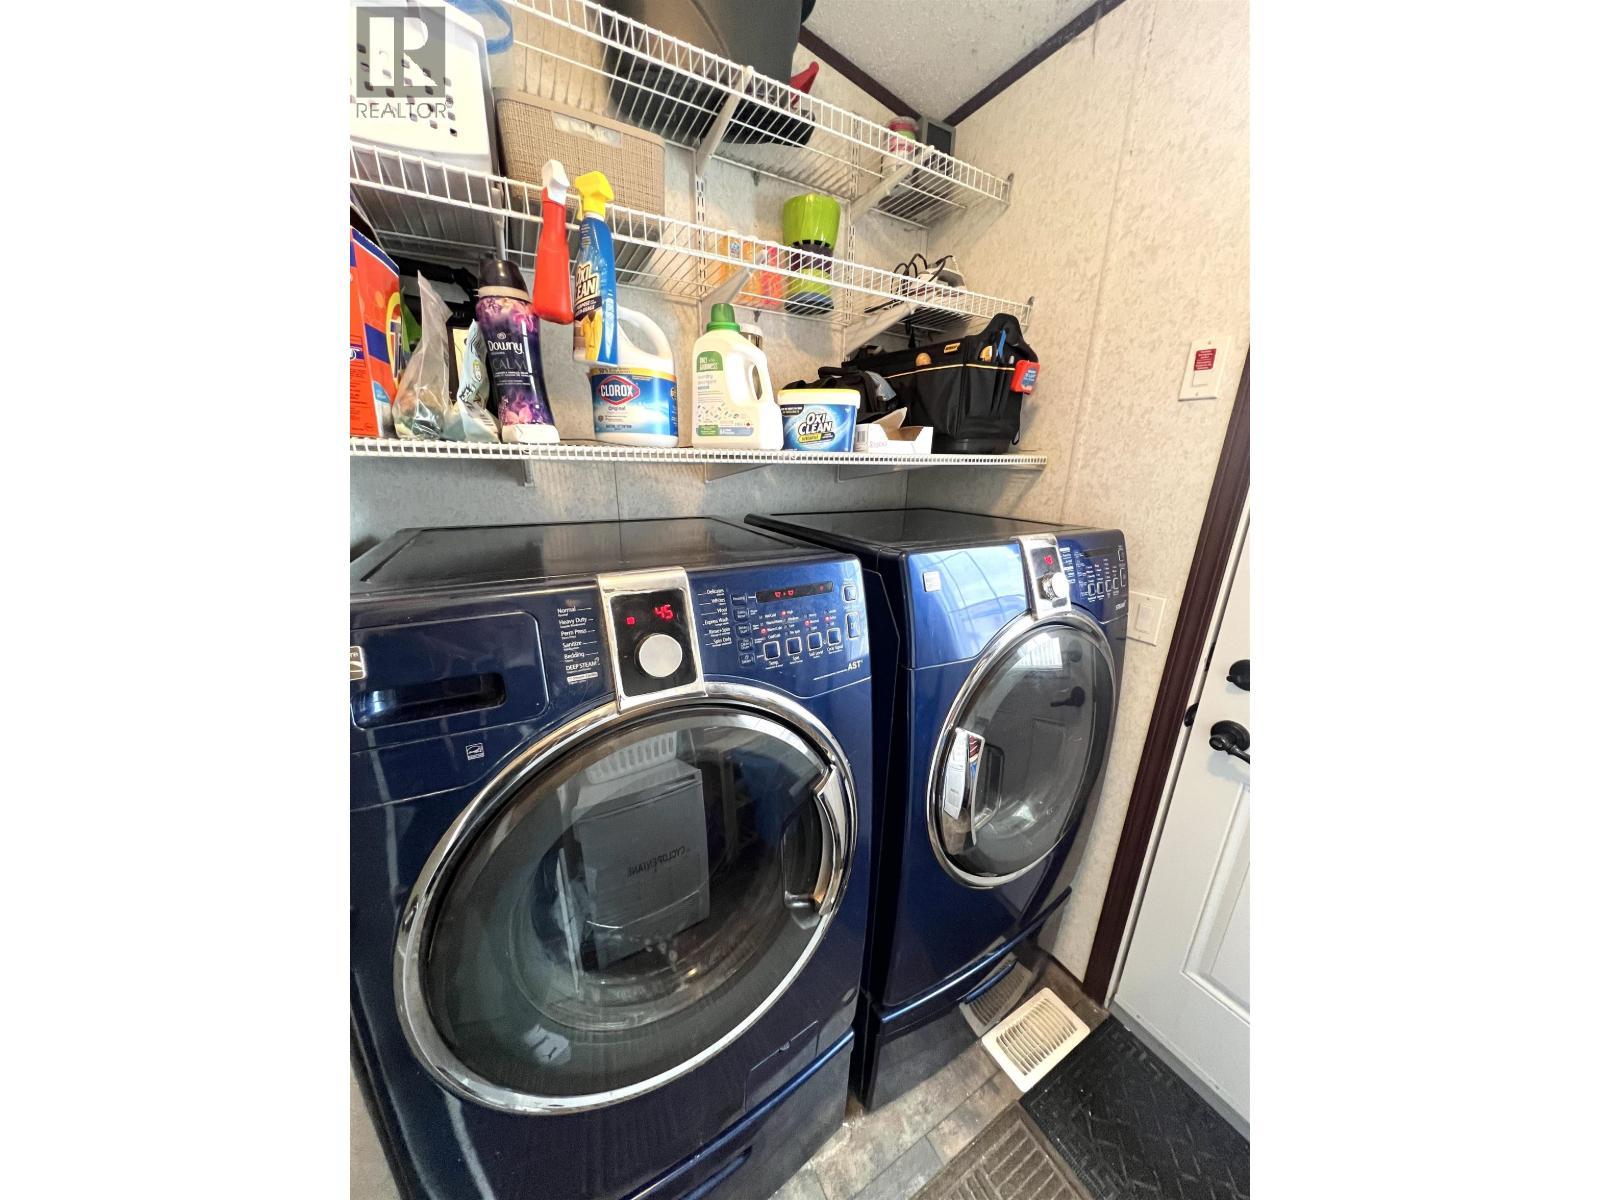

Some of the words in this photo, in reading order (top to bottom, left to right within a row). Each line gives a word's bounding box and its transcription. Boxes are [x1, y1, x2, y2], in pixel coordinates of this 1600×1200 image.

[487, 340, 523, 355] Downy
[600, 384, 634, 397] CLOROX
[806, 412, 827, 425] OXI
[799, 421, 834, 436] CLEAN
[557, 606, 577, 614] Normal
[655, 604, 675, 619] 45
[564, 651, 585, 659] Bedding
